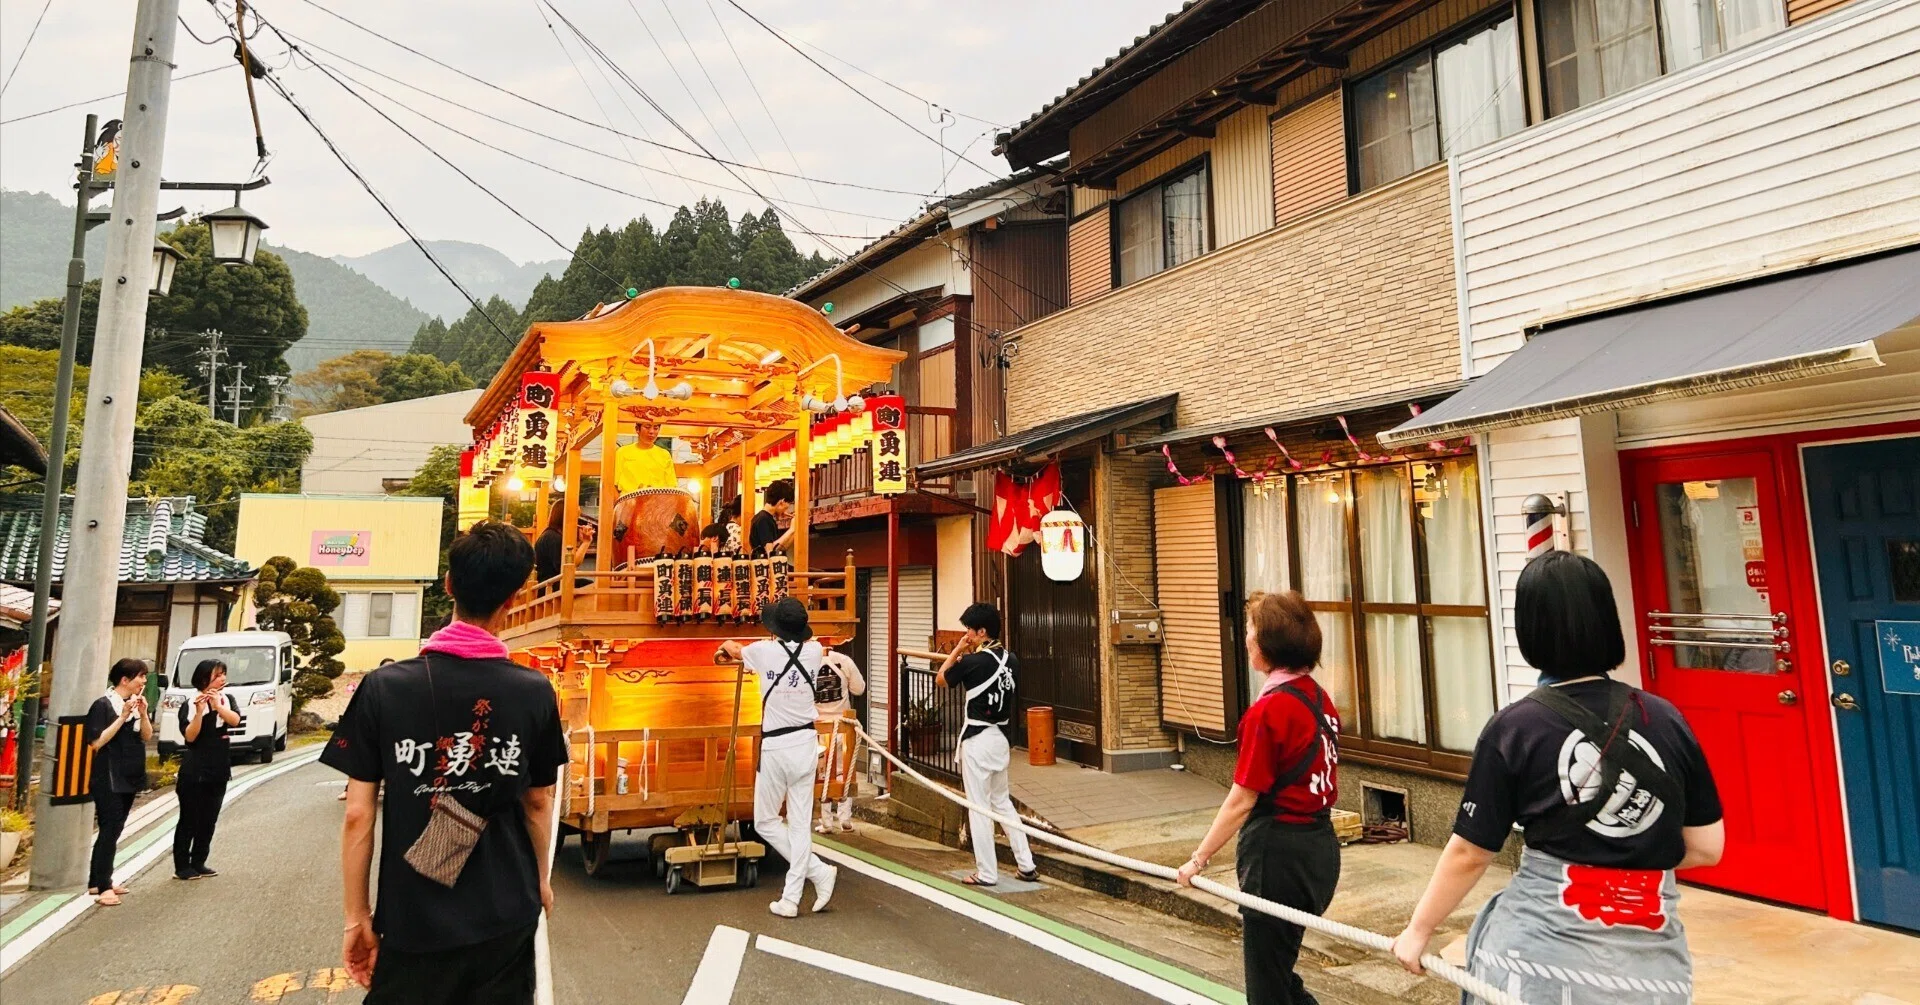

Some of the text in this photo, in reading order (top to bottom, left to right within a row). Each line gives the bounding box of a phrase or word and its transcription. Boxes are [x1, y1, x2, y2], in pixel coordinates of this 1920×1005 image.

[522, 383, 554, 468] 町勇連
[878, 405, 901, 481] 町勇連
[318, 545, 364, 556] HoneyDep
[656, 563, 674, 613] 町勇連
[395, 731, 521, 777] 町勇連
